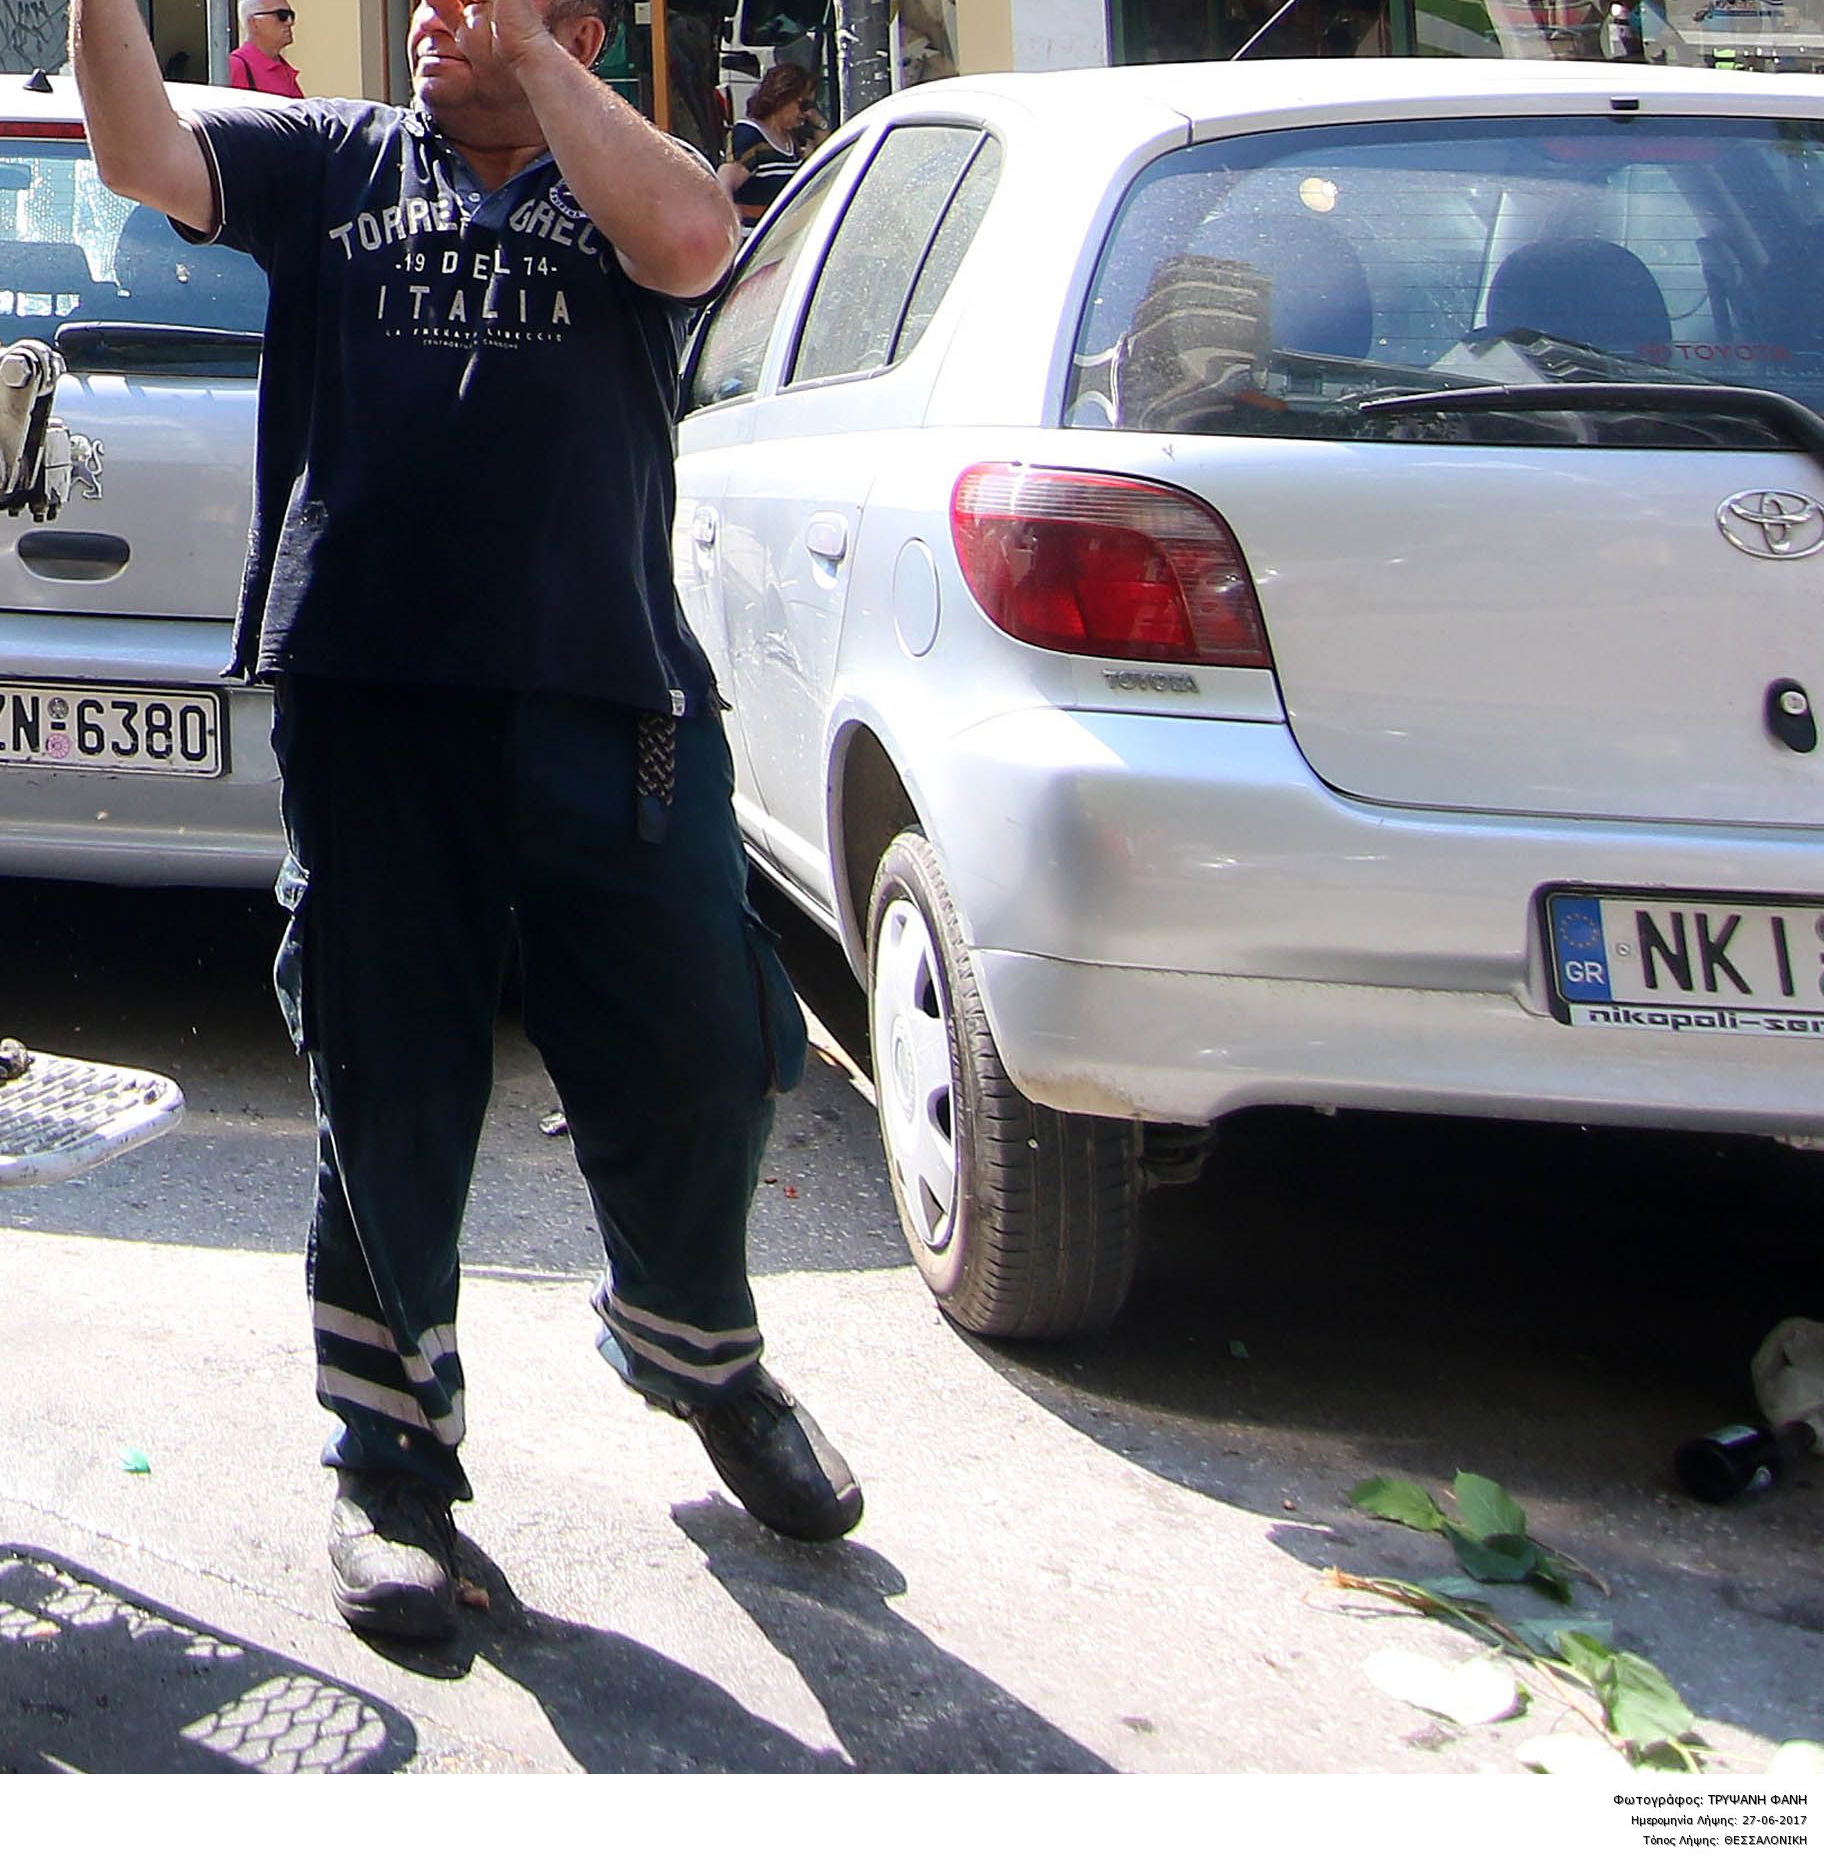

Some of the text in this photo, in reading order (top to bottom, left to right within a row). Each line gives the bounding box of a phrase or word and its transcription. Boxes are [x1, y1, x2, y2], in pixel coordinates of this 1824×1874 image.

[509, 198, 609, 275] GREC
[440, 247, 511, 280] DEL
[376, 284, 572, 326] ITALIA
[1674, 343, 1794, 362] TOYOTA
[1101, 667, 1202, 695] TOYOTA
[1564, 960, 1605, 986] GR
